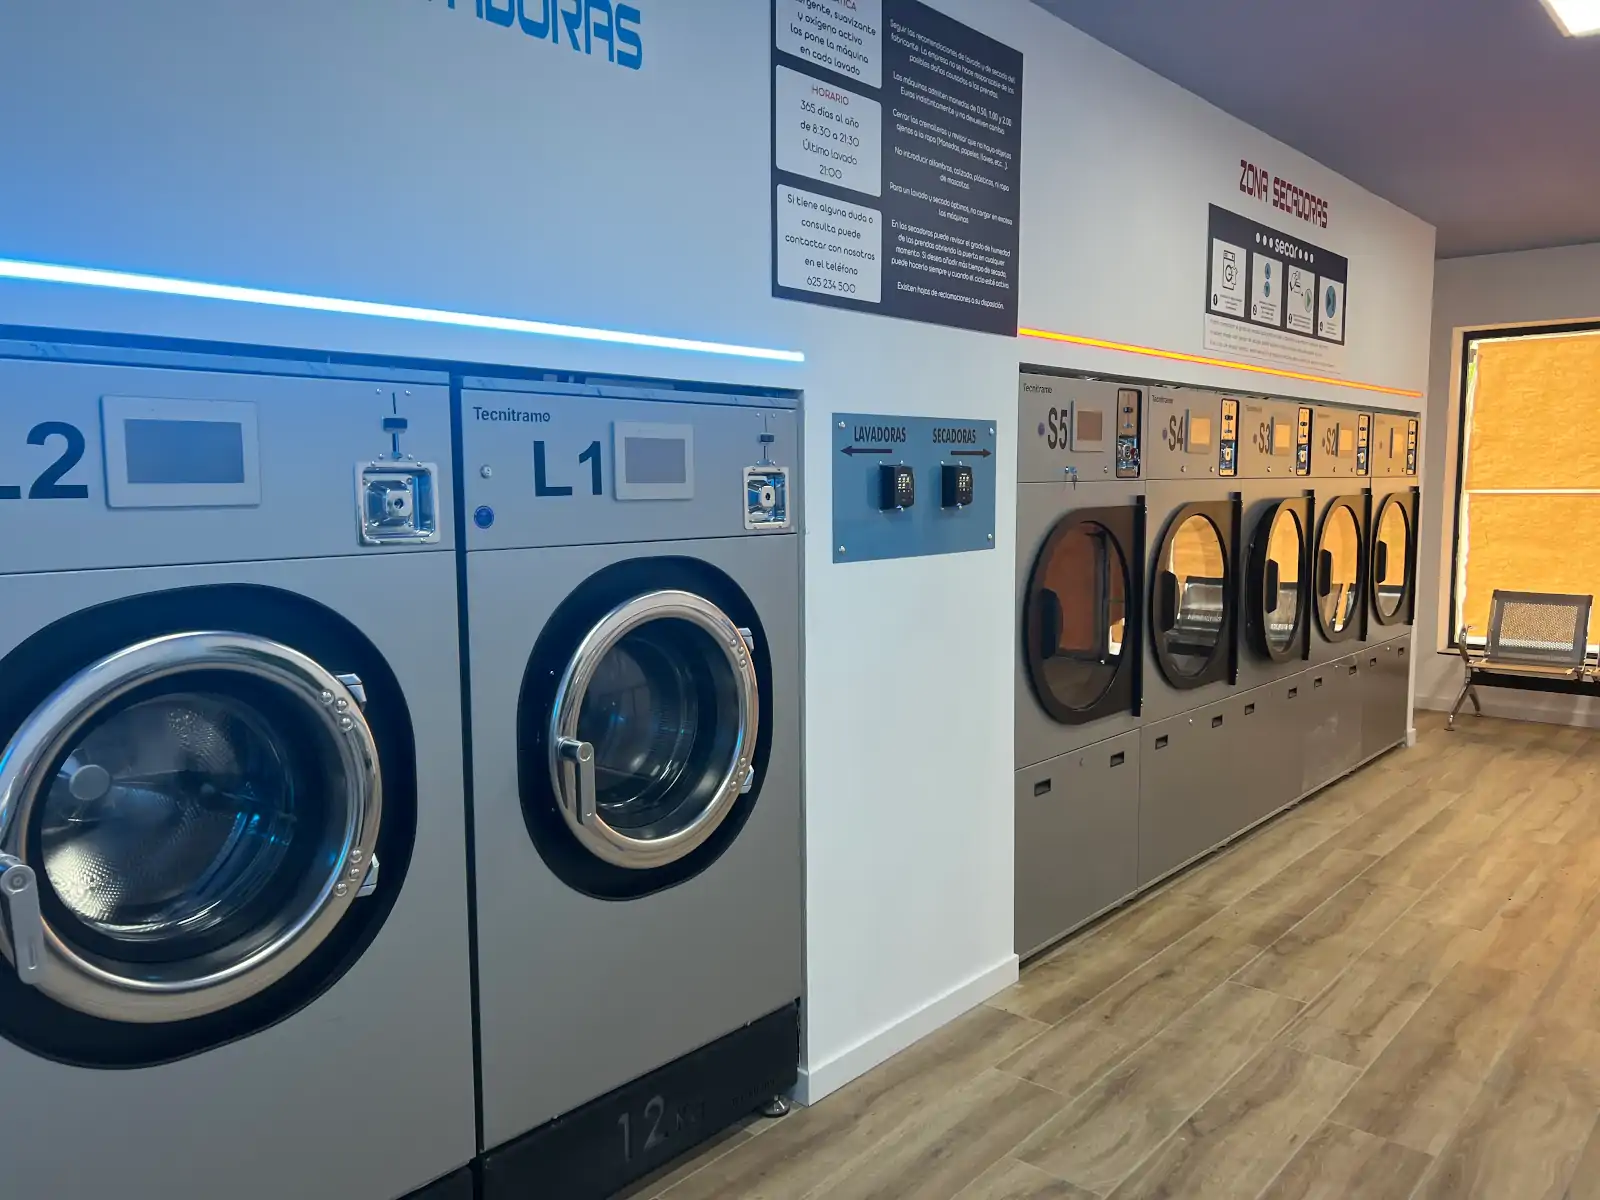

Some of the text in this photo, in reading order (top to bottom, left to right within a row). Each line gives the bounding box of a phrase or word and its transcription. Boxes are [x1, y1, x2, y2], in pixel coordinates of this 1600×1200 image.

[798, 12, 862, 45] y oxígeno activo
[835, 12, 876, 35] suavizante
[801, 46, 860, 75] en cada lavado
[804, 31, 824, 45] pone
[827, 39, 834, 49] la
[837, 45, 868, 63] máquina
[812, 84, 849, 106] HORARIO
[800, 100, 859, 128] 365 días al año
[800, 120, 810, 130] de
[812, 124, 831, 138] 8:30
[840, 133, 859, 147] 21:30
[803, 139, 857, 165] Último lavado
[820, 165, 842, 179] 21:00
[1240, 159, 1328, 229] ZONA SECADORAS
[788, 194, 795, 204] Si
[797, 197, 818, 210] tiene
[820, 204, 846, 216] alguna
[848, 210, 867, 222] duda
[801, 219, 861, 239] consulta puede
[785, 234, 875, 260] contactar con nosotros
[1275, 238, 1298, 259] secar
[805, 259, 858, 275] en el teléfono
[807, 276, 856, 293] 625 234 500
[473, 406, 550, 423] Tecnitramo
[854, 426, 976, 444] LAVADORAS SECADORAS
[1048, 407, 1068, 450] S5
[1168, 415, 1184, 451] S4
[1258, 422, 1271, 454] S3
[1325, 428, 1336, 455] S2
[533, 440, 602, 497] L1
[618, 1095, 668, 1163] 12
